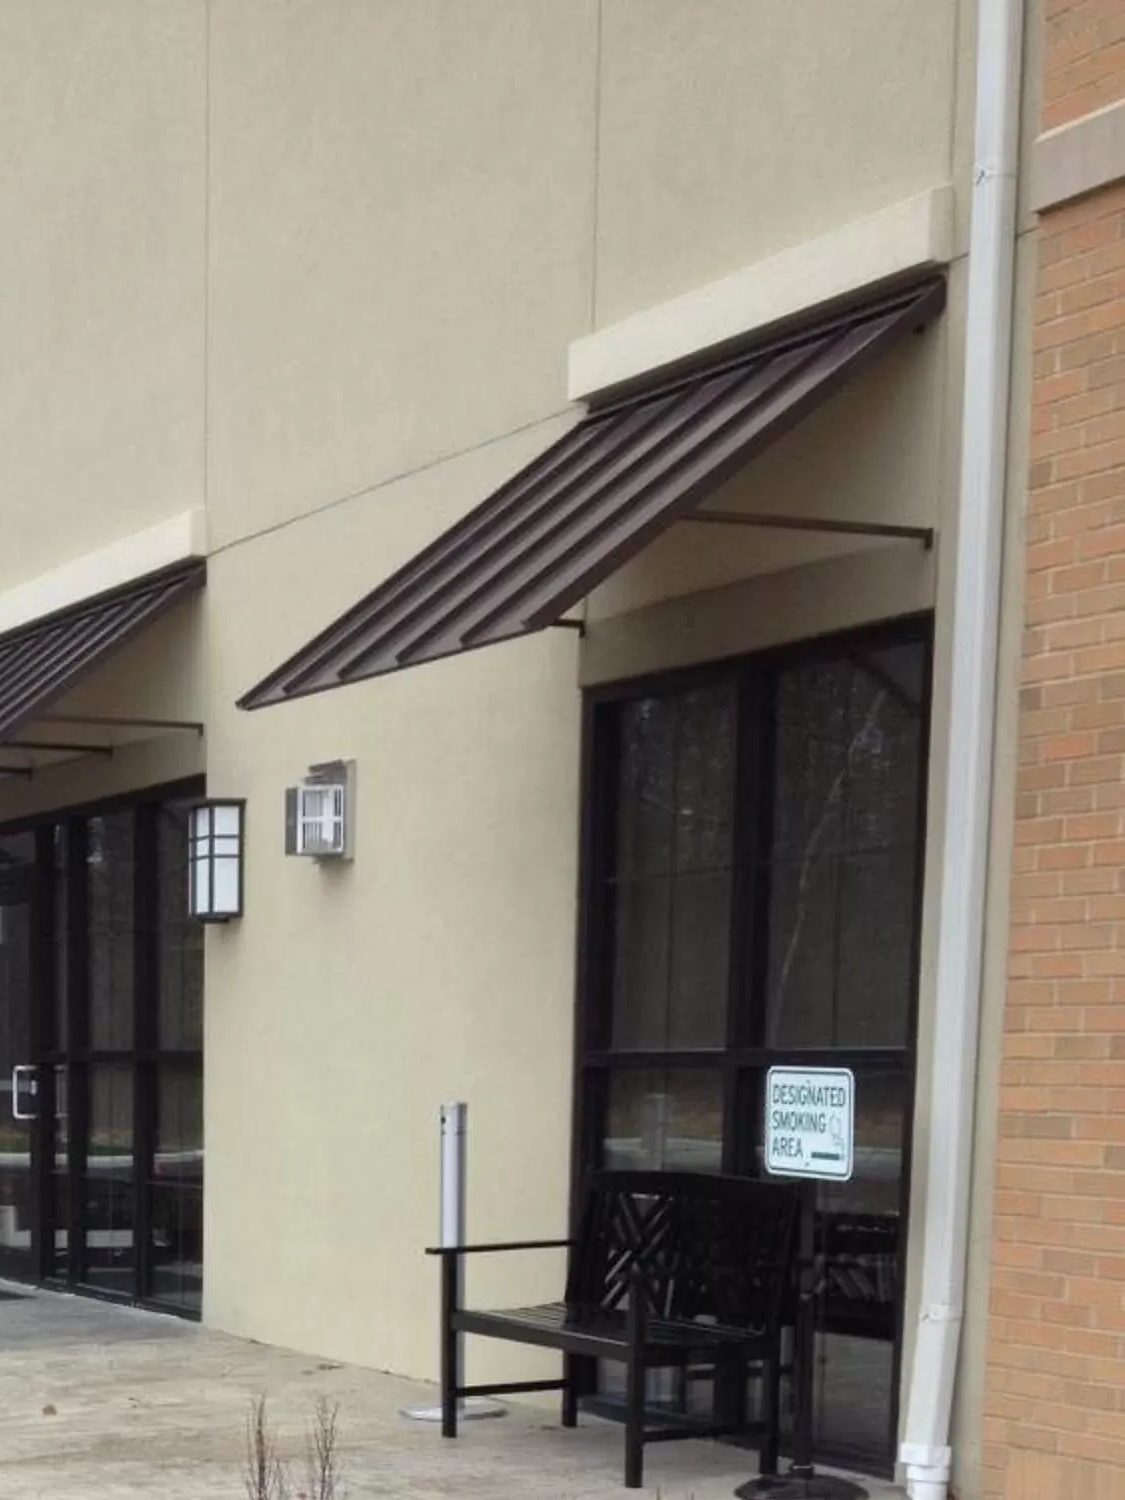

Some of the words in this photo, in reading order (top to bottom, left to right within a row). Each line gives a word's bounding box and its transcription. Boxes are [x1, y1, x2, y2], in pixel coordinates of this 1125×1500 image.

[773, 1084, 845, 1106] DESIGNATED
[772, 1110, 826, 1133] SMOKING
[772, 1136, 803, 1157] AREA
